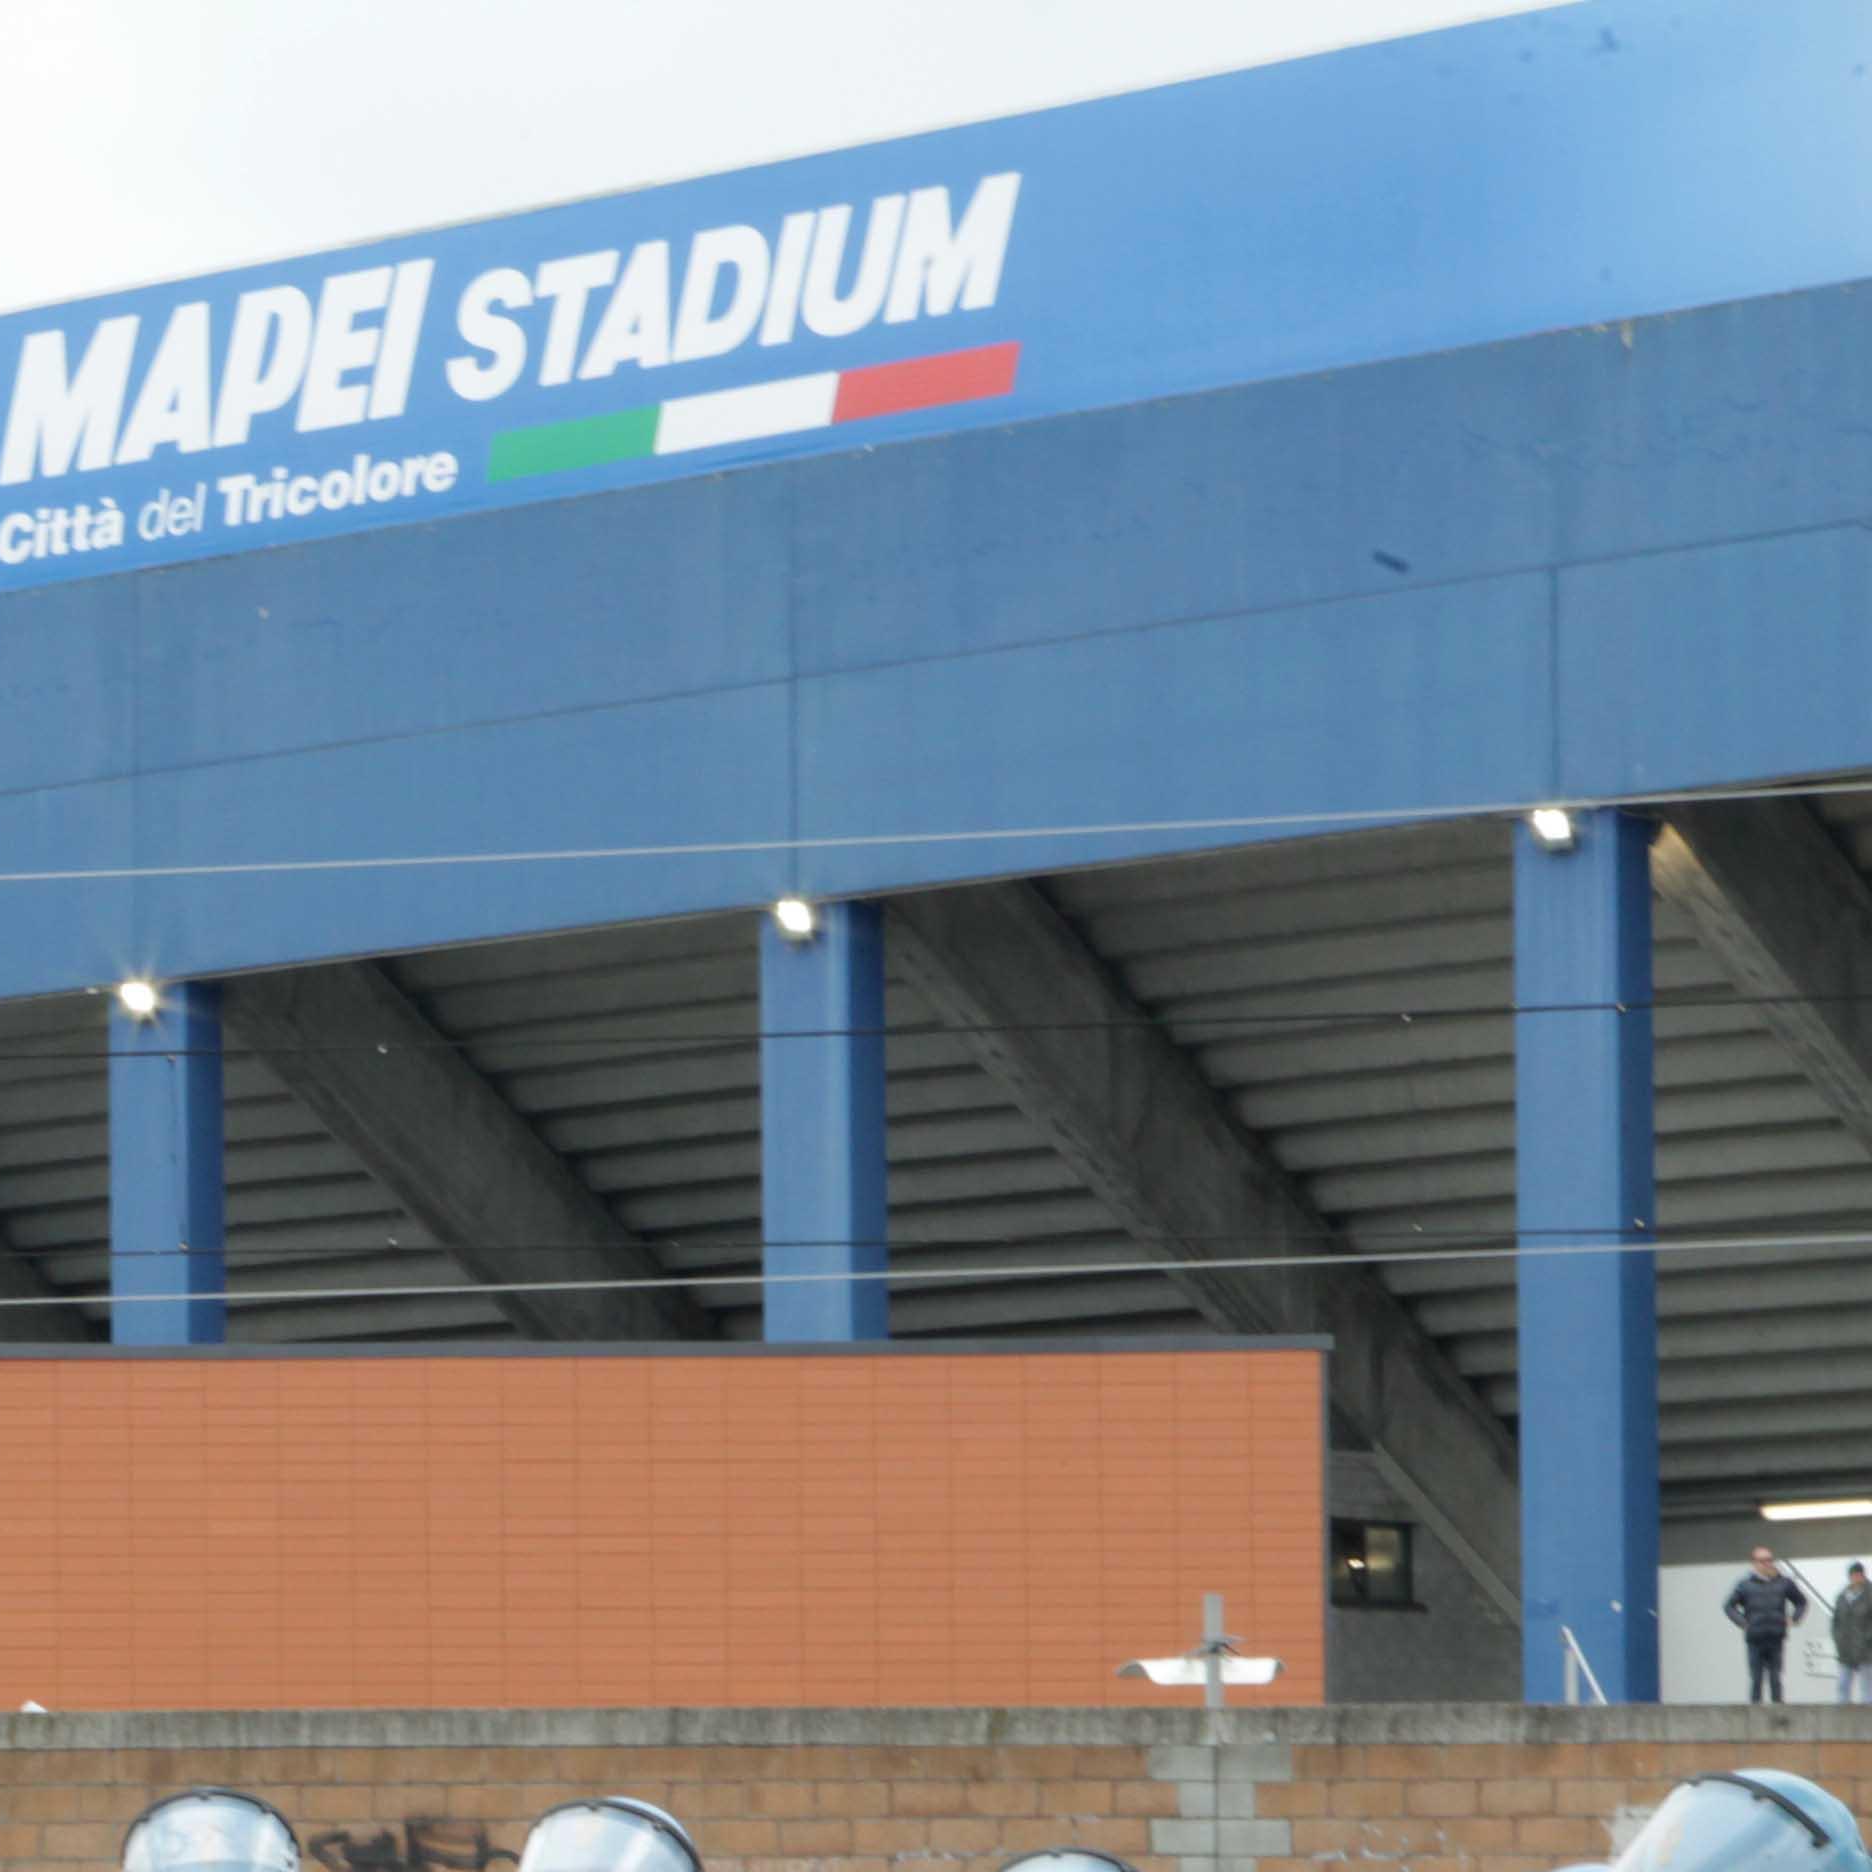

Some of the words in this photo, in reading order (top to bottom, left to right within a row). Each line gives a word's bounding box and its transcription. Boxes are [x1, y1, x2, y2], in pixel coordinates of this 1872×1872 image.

[445, 170, 1022, 403] STADIUM
[136, 478, 207, 543] del
[217, 447, 459, 531] Tricolore
